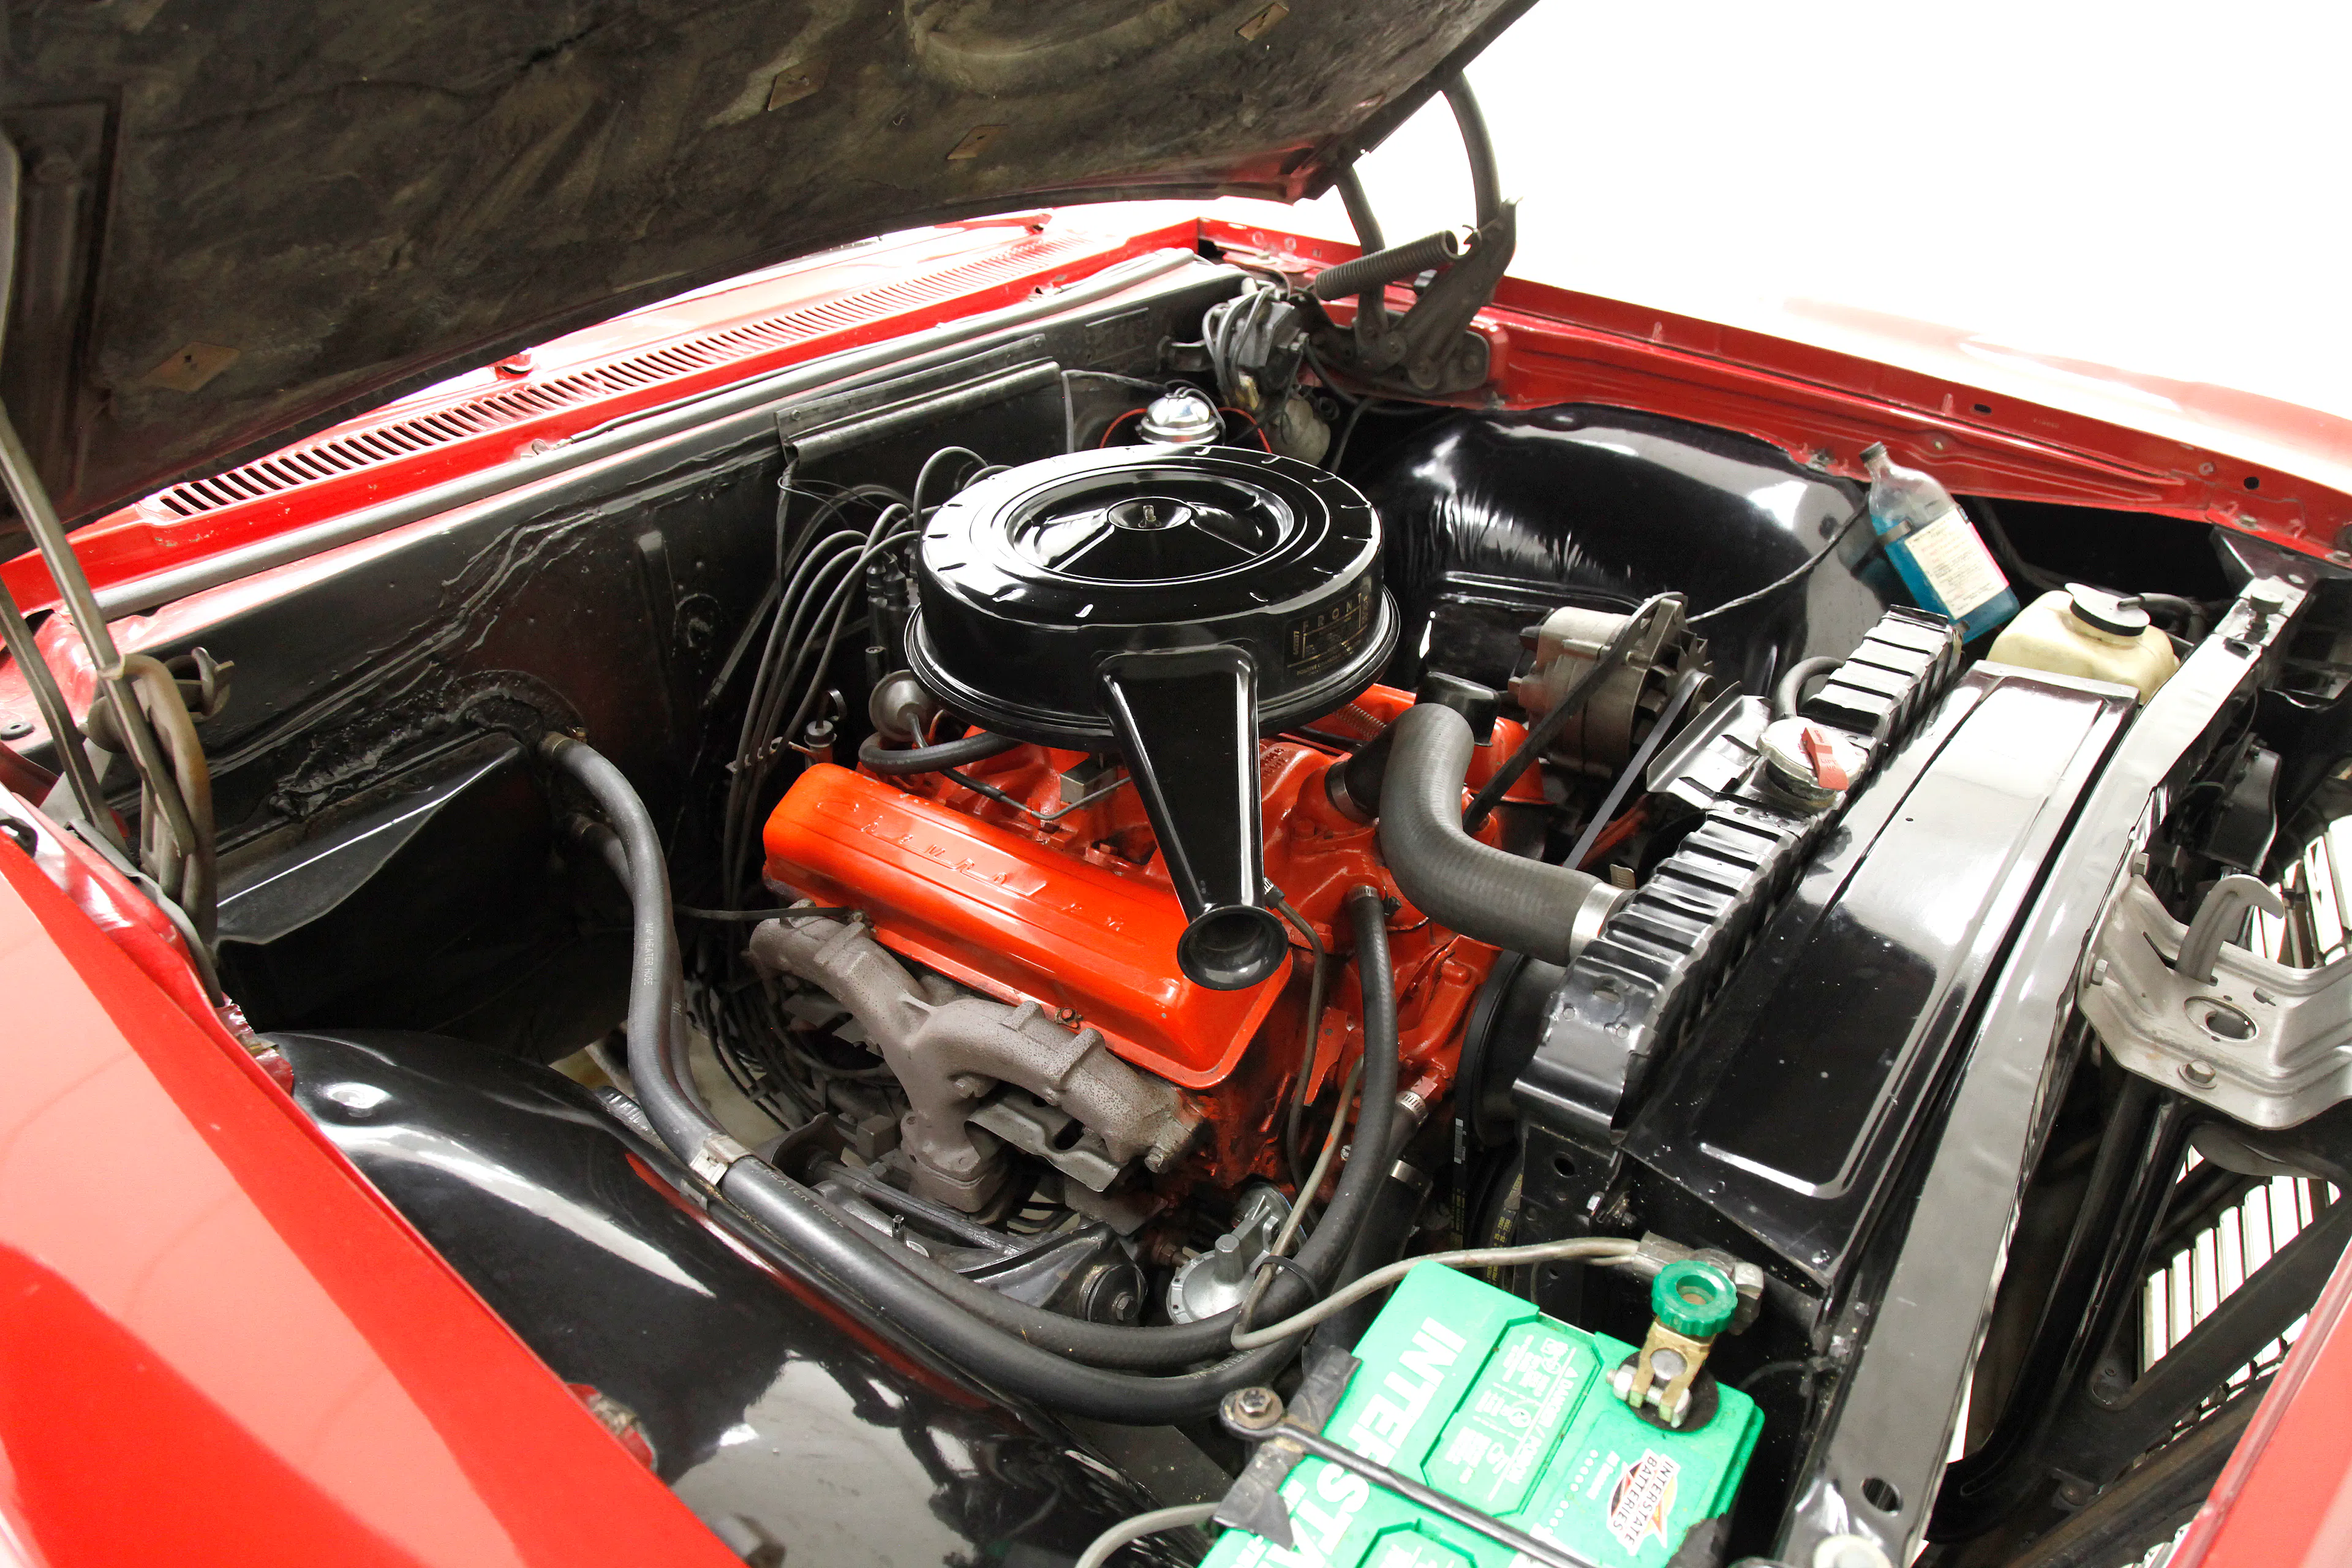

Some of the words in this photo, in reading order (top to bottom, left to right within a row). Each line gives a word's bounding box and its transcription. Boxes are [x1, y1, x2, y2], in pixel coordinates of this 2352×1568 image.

[644, 938, 654, 967] HEATER
[644, 968, 653, 986] HOSE
[1212, 1354, 1246, 1374] HEATER
[1613, 1455, 1657, 1531] BATTERIES
[1624, 1461, 1674, 1545] INTERSTATE
